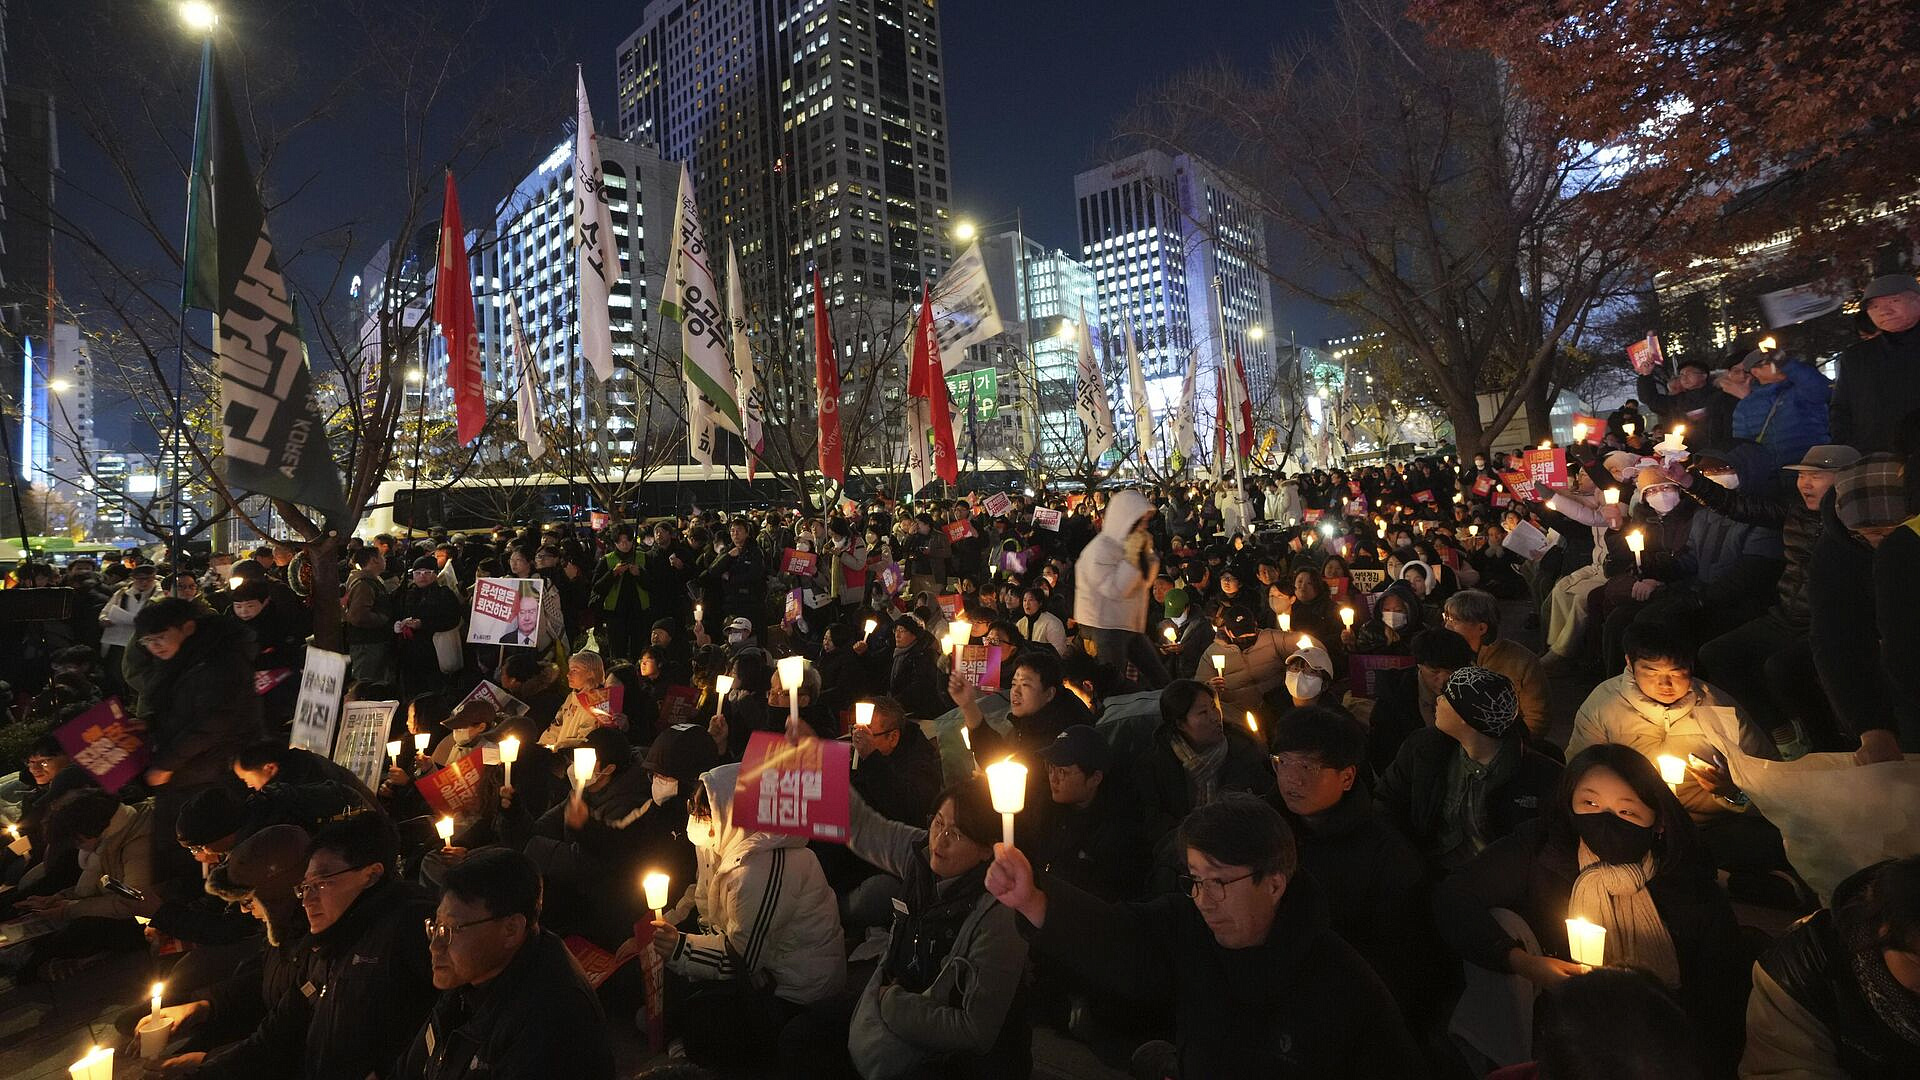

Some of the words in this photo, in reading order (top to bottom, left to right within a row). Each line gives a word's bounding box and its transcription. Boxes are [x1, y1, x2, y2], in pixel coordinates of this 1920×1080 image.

[479, 583, 516, 605] 윤석열은
[476, 597, 513, 620] 퇴진하라
[759, 768, 823, 801] 윤석열
[757, 795, 808, 827] 퇴진!
